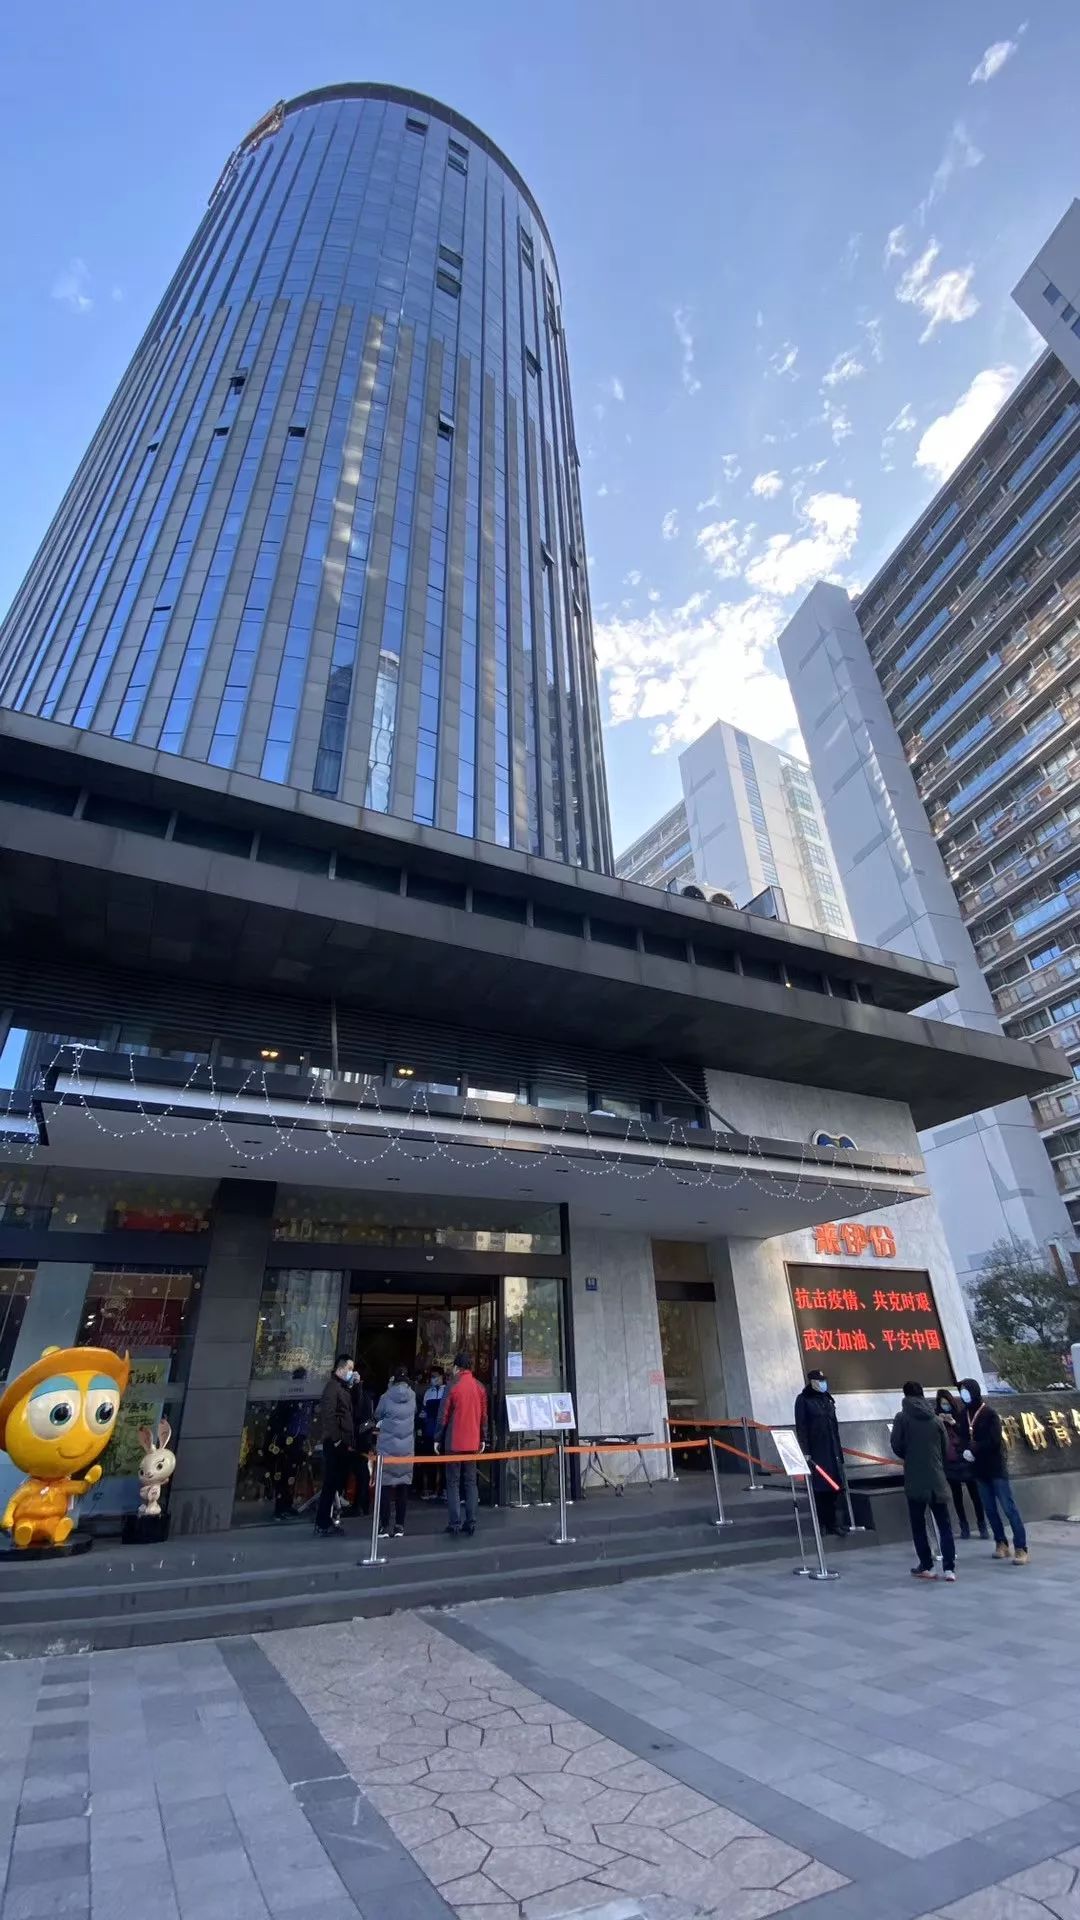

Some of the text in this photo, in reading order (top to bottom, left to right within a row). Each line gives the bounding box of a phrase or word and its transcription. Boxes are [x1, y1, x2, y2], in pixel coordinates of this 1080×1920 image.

[794, 1287, 932, 1312] 抗击疫情、共克时艰
[802, 1327, 942, 1352] 武汉加油、平安中国
